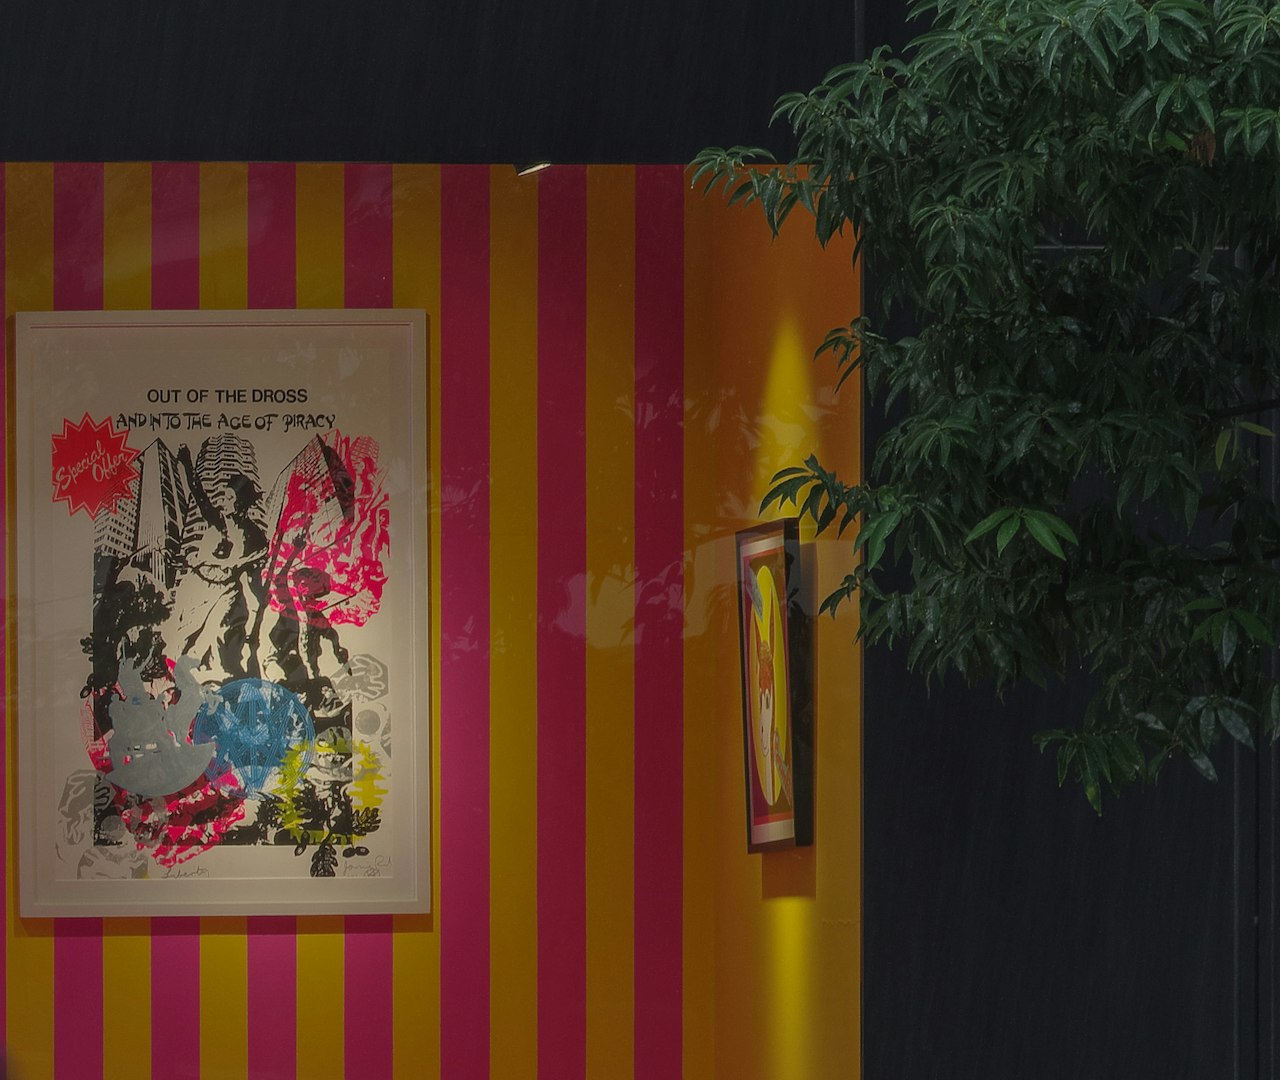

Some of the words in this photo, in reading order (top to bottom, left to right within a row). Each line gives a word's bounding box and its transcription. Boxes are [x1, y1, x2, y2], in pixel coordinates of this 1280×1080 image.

[147, 388, 182, 404] OUT
[187, 388, 209, 404] OF
[215, 388, 247, 404] THE
[252, 388, 309, 404] DROSS
[116, 412, 147, 431] AND
[183, 412, 212, 429] THE
[217, 413, 251, 430] AGE
[255, 413, 279, 430] OF
[282, 413, 337, 432] PIRACY
[55, 439, 107, 490] Special
[91, 452, 129, 483] Offer
